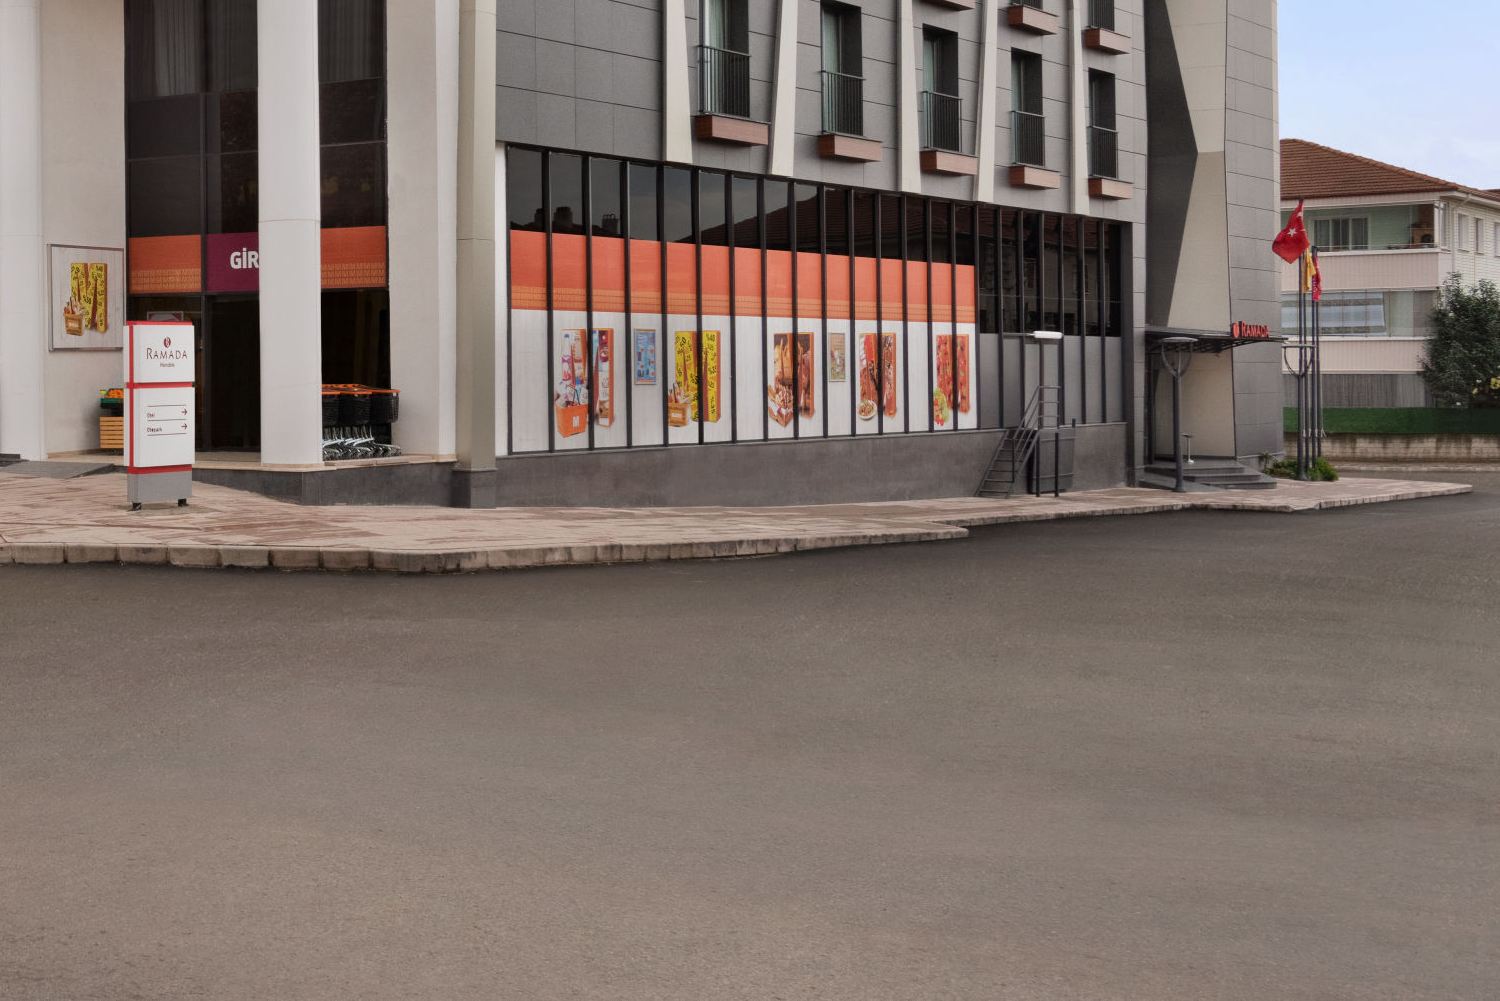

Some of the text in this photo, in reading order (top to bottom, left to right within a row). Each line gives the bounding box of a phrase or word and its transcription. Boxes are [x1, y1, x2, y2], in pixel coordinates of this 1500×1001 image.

[229, 248, 259, 269] GİR
[1241, 321, 1269, 337] RAMADA
[146, 347, 188, 360] RAMADA
